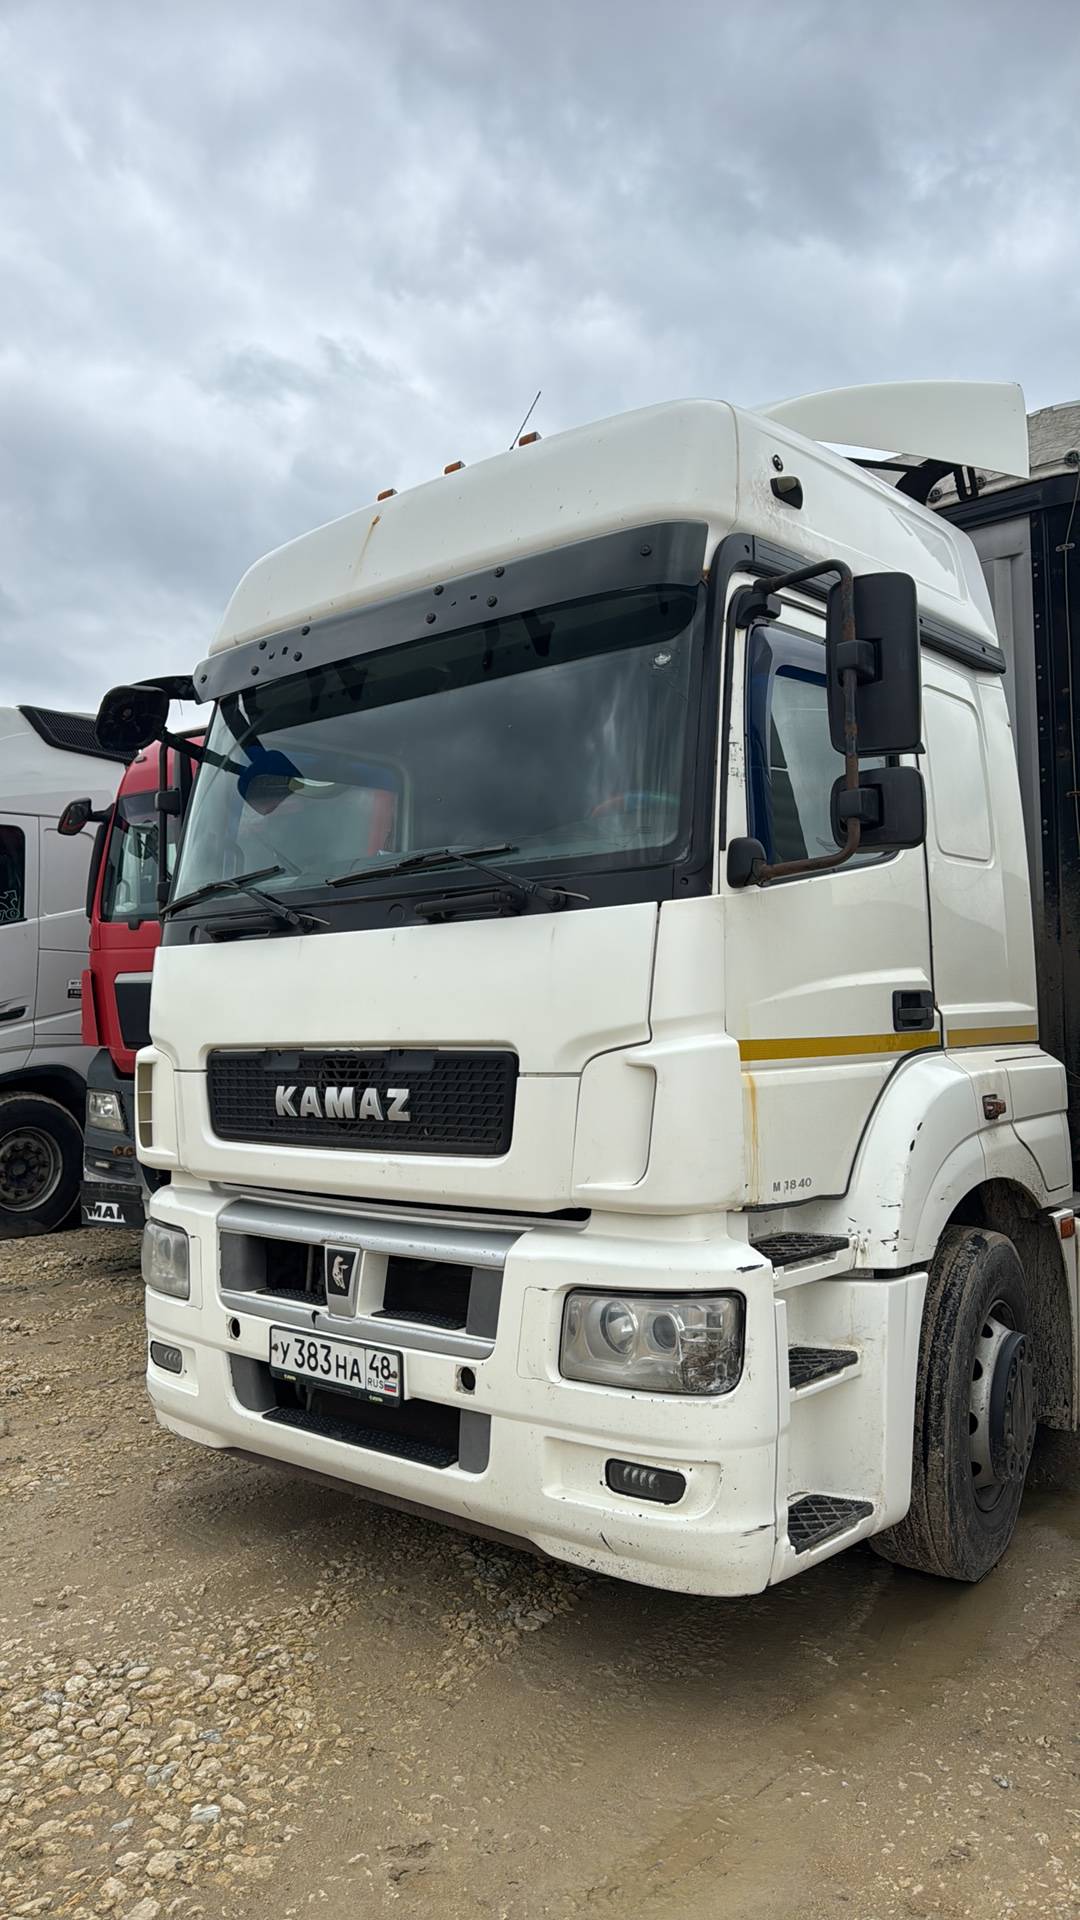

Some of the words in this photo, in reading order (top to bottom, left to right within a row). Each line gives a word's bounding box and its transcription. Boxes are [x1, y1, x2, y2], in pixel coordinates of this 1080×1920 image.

[275, 1085, 411, 1122] KAMAZ
[772, 1181, 781, 1192] M
[784, 1177, 812, 1190] 1840
[369, 1354, 391, 1380] 48
[367, 1377, 384, 1390] RUS
